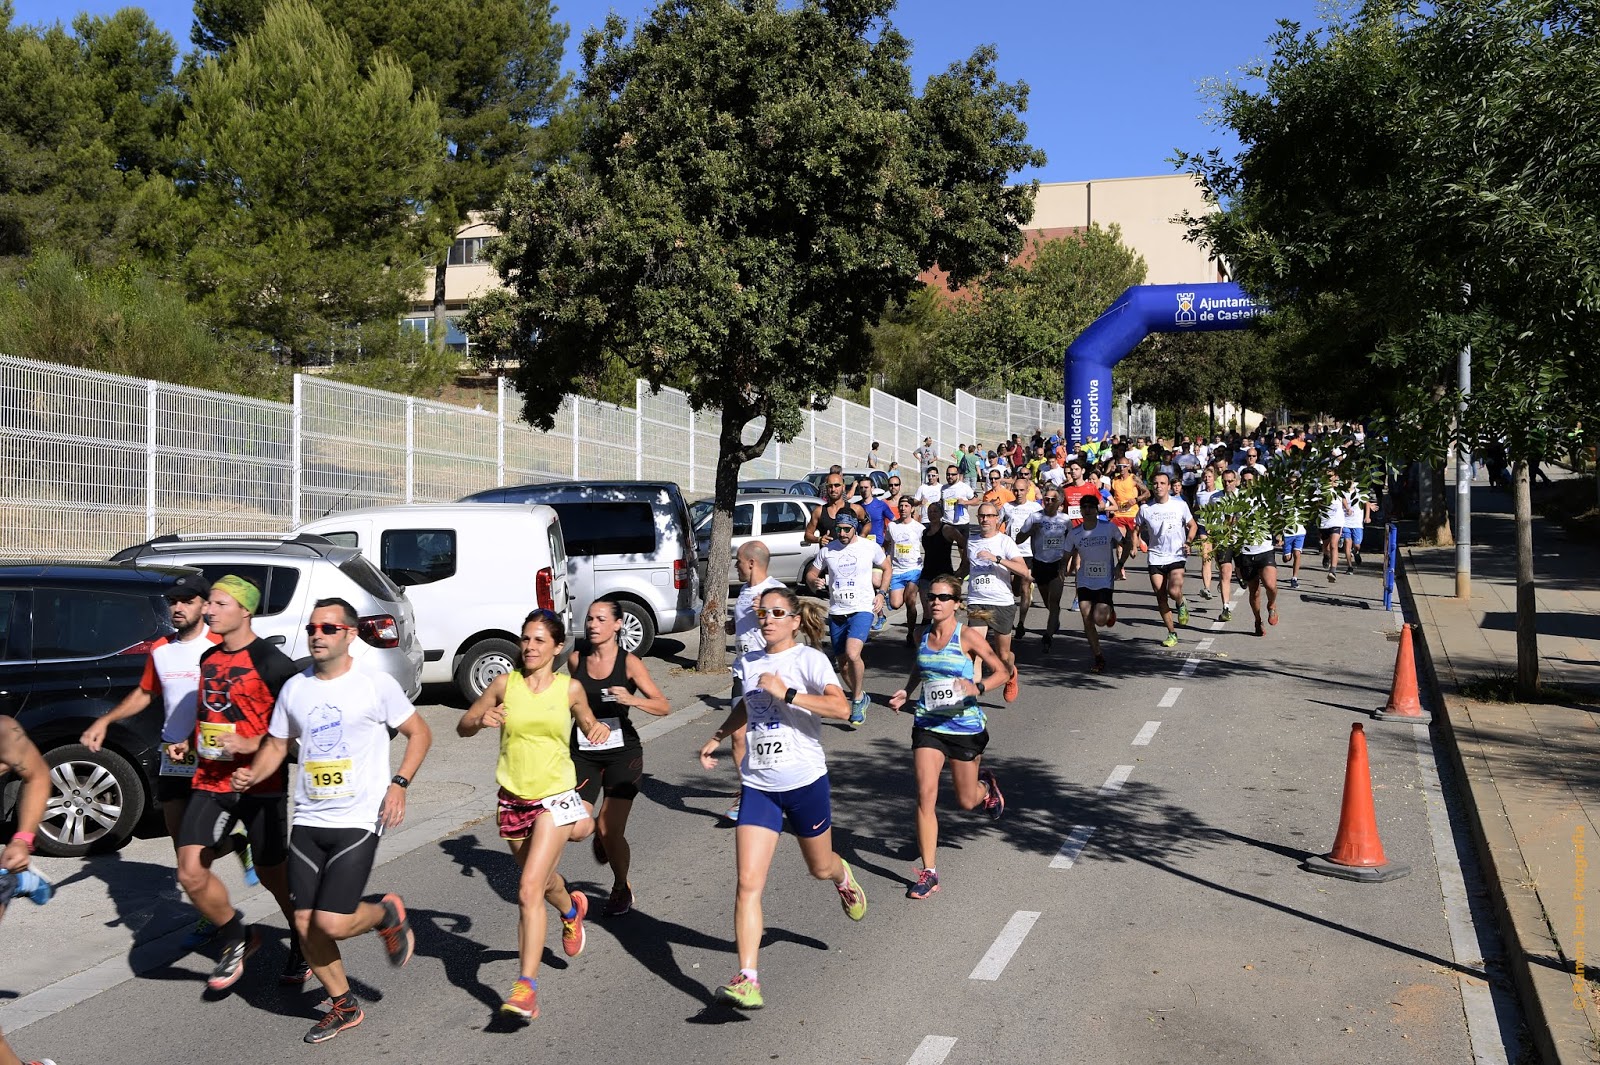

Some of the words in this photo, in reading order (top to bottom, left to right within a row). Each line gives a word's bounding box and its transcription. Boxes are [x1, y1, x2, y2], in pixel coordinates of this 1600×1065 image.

[1200, 311, 1214, 321] de
[1087, 379, 1101, 435] esportiva
[1070, 398, 1082, 442] lldefels
[839, 592, 855, 600] 115
[931, 689, 953, 701] 099
[756, 741, 783, 756] 072
[314, 772, 343, 786] 193
